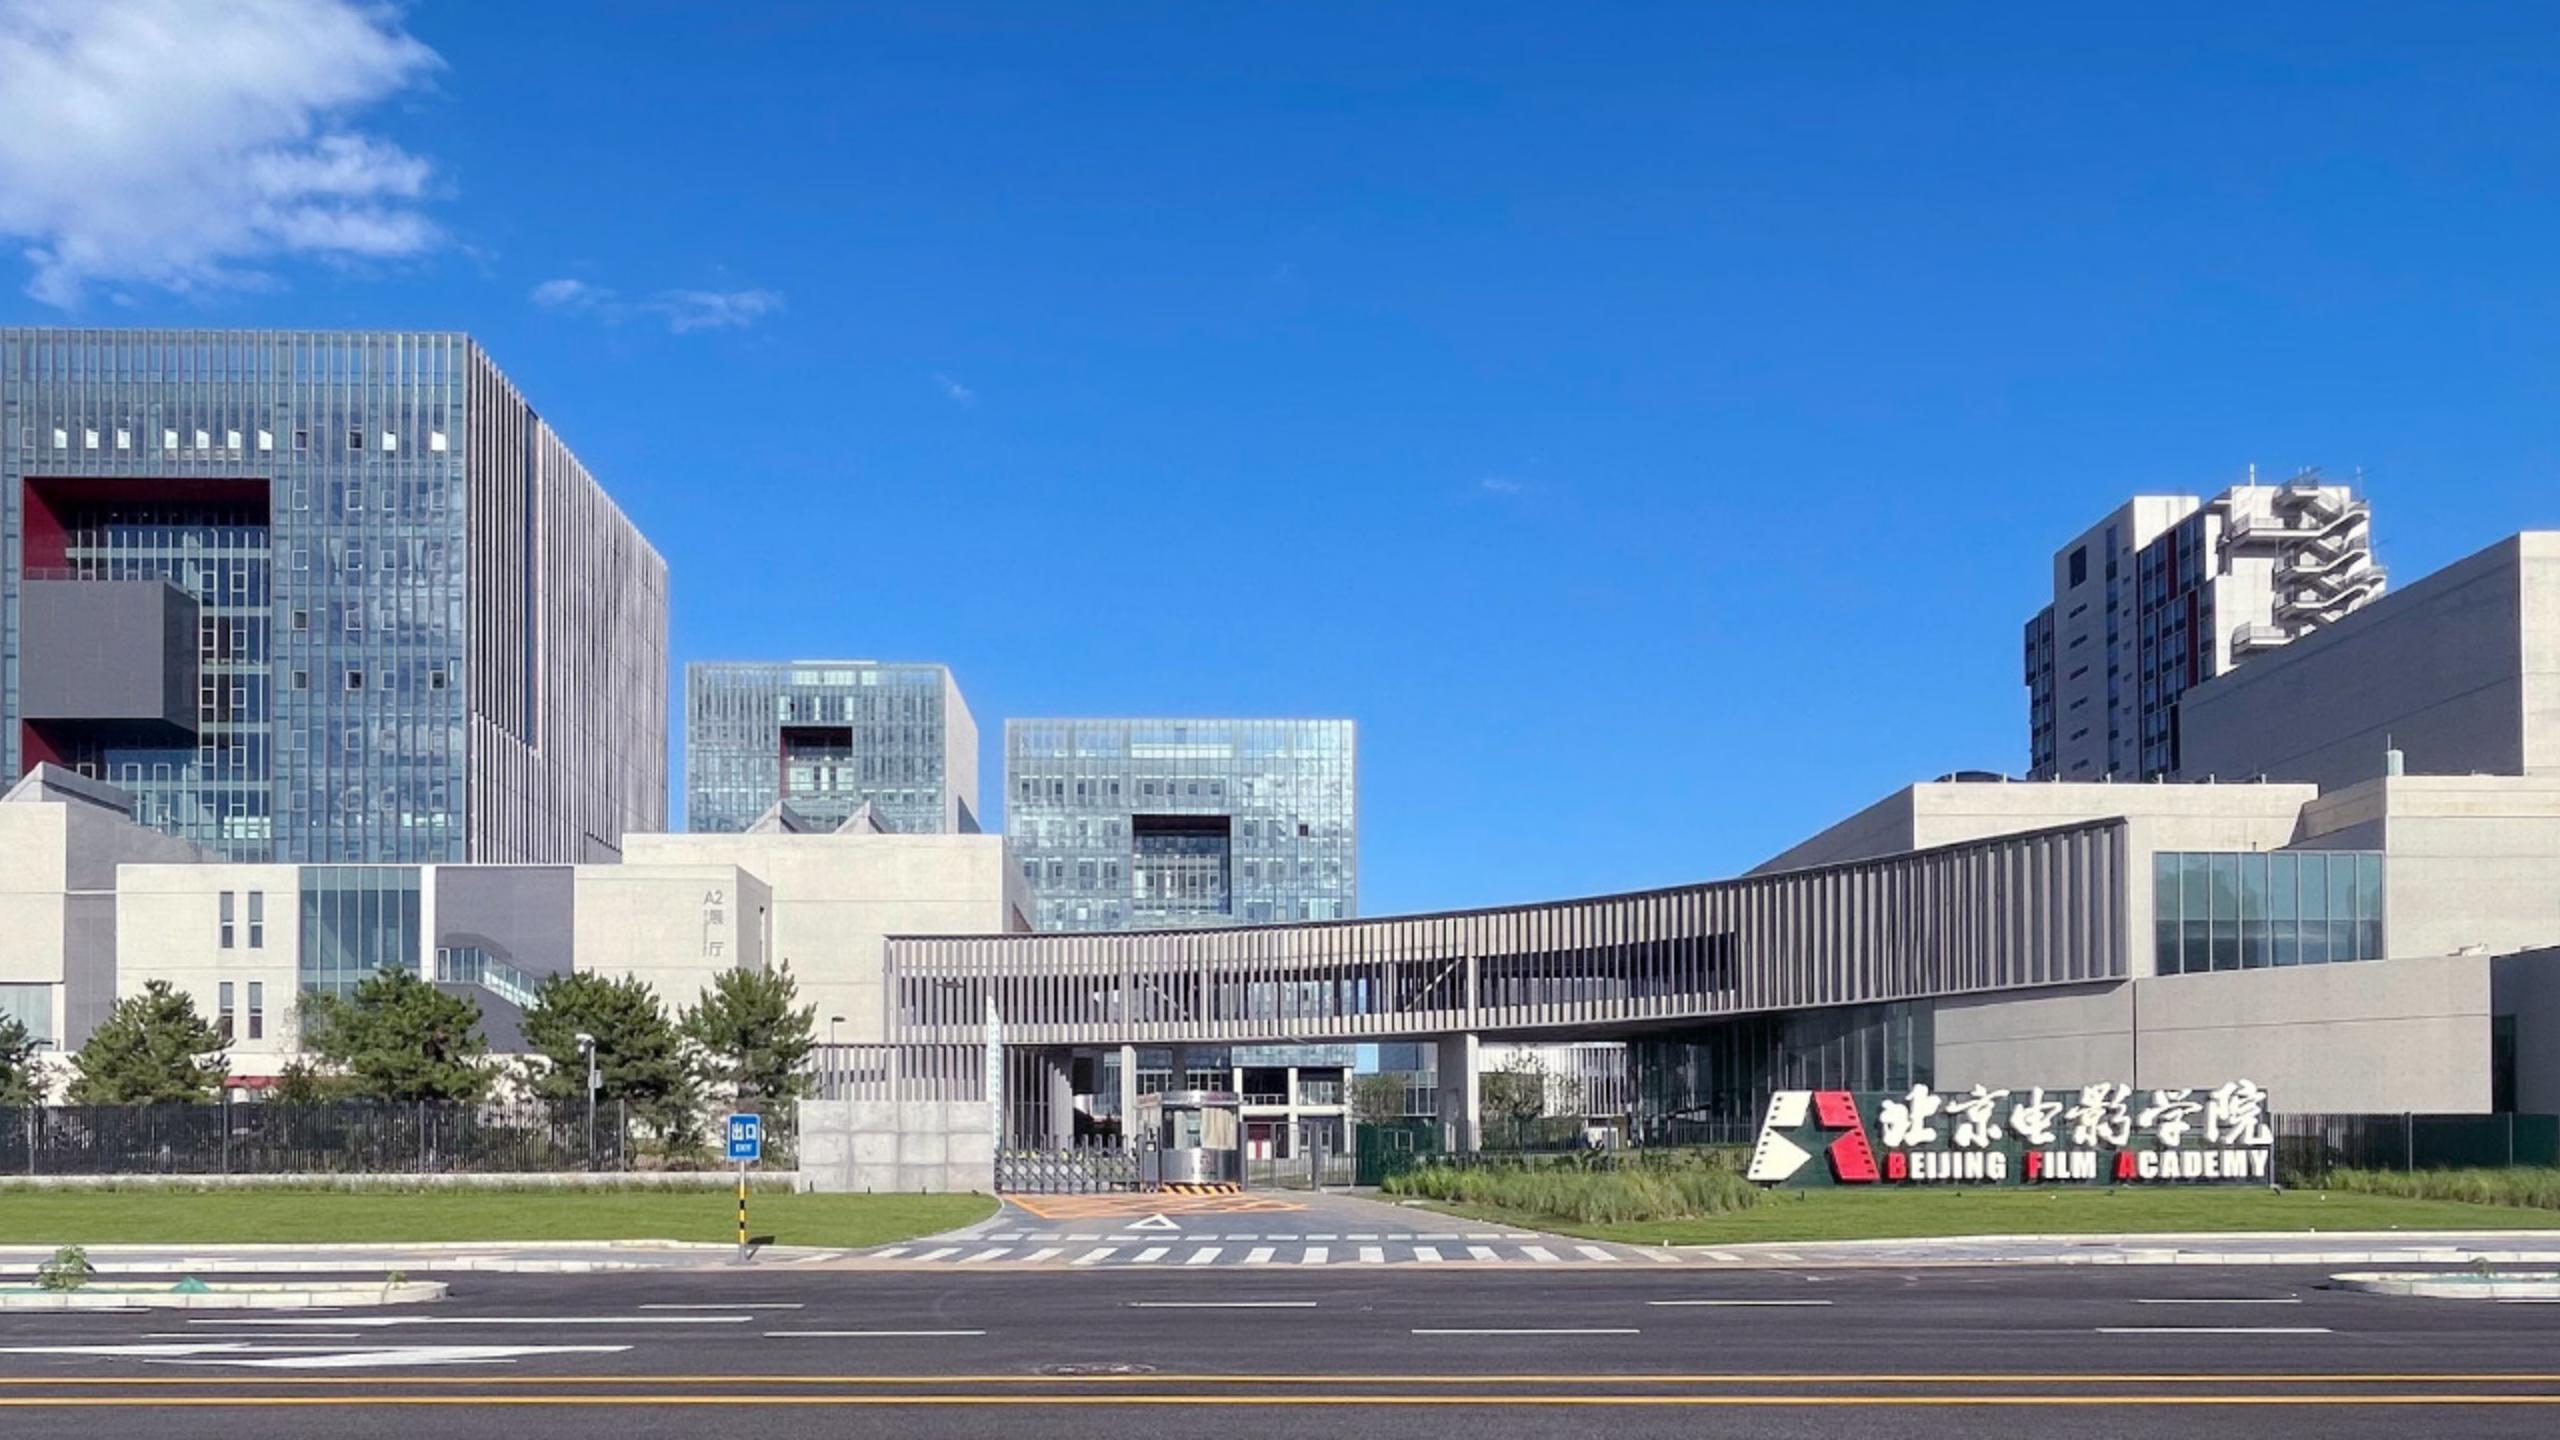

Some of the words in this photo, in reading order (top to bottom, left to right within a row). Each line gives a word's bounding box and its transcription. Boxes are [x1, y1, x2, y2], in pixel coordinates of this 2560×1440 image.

[703, 889, 723, 905] A2
[1880, 1079, 2273, 1147] 北京电影学院
[731, 1122, 757, 1141] 出口
[1887, 1150, 2007, 1180] BEIJING
[2026, 1150, 2097, 1180] FILM
[2117, 1149, 2268, 1180] ACADEMY
